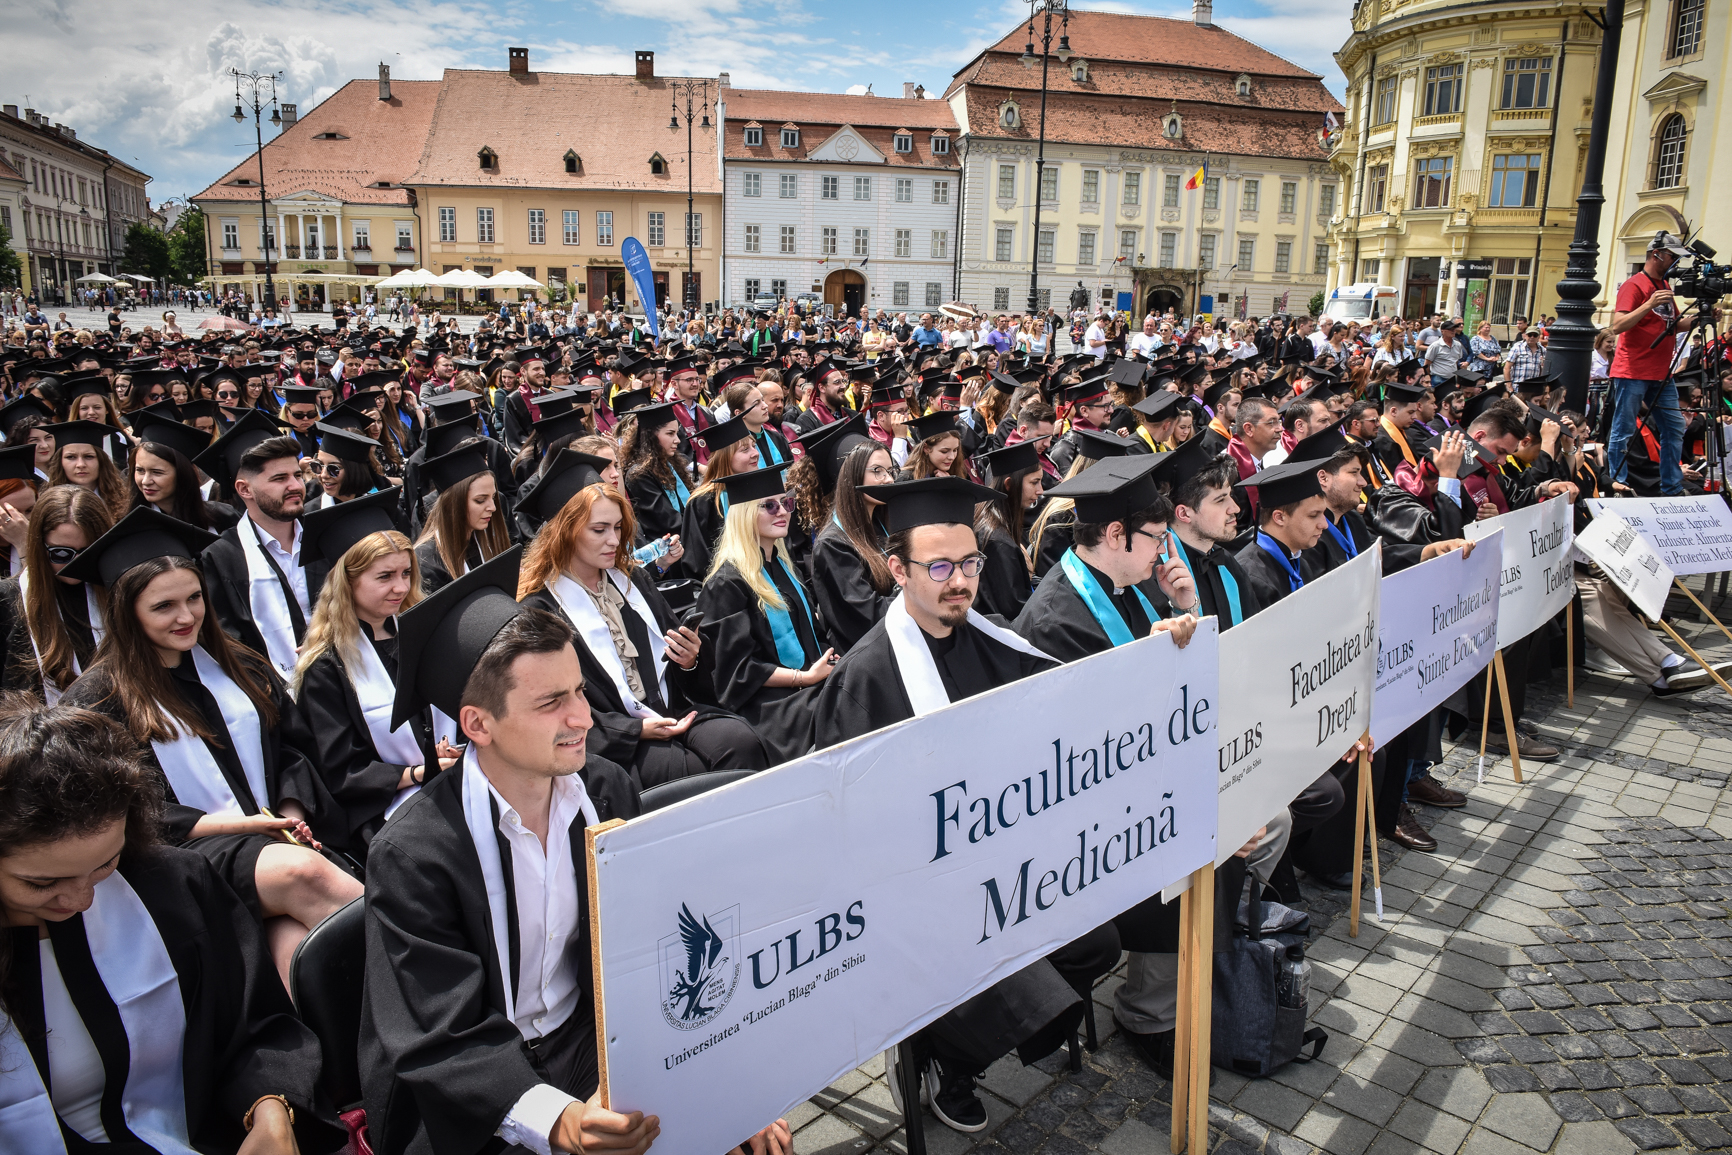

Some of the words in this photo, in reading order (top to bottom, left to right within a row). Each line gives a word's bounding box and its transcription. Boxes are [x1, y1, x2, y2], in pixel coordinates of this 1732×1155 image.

[1622, 517, 1644, 527] LBS
[1650, 502, 1697, 514] Facultatea
[1695, 500, 1709, 512] de
[1686, 515, 1723, 531] Agricole
[1653, 533, 1695, 548] Industrie
[1432, 593, 1480, 635] Facultatea
[1481, 578, 1492, 605] de
[1387, 639, 1414, 670] ULBS
[1453, 616, 1497, 666] Economice
[1290, 633, 1361, 709] Facultatea
[1363, 611, 1375, 649] de
[1316, 686, 1358, 748] Drept
[1218, 721, 1262, 773] ULBS
[929, 722, 1157, 864] Facultatea
[1168, 684, 1210, 746] de
[747, 900, 866, 990] ULBS
[708, 983, 725, 996] AGITAT
[708, 989, 726, 1002] MOLEM
[709, 978, 724, 989] MENS
[662, 1000, 685, 1030] UNIVERSITAS
[685, 1018, 707, 1030] LUCIAN
[707, 1003, 725, 1022] BLAGA
[664, 1022, 740, 1071] Universitatea
[824, 962, 839, 983] din
[841, 952, 866, 974] Sibiu
